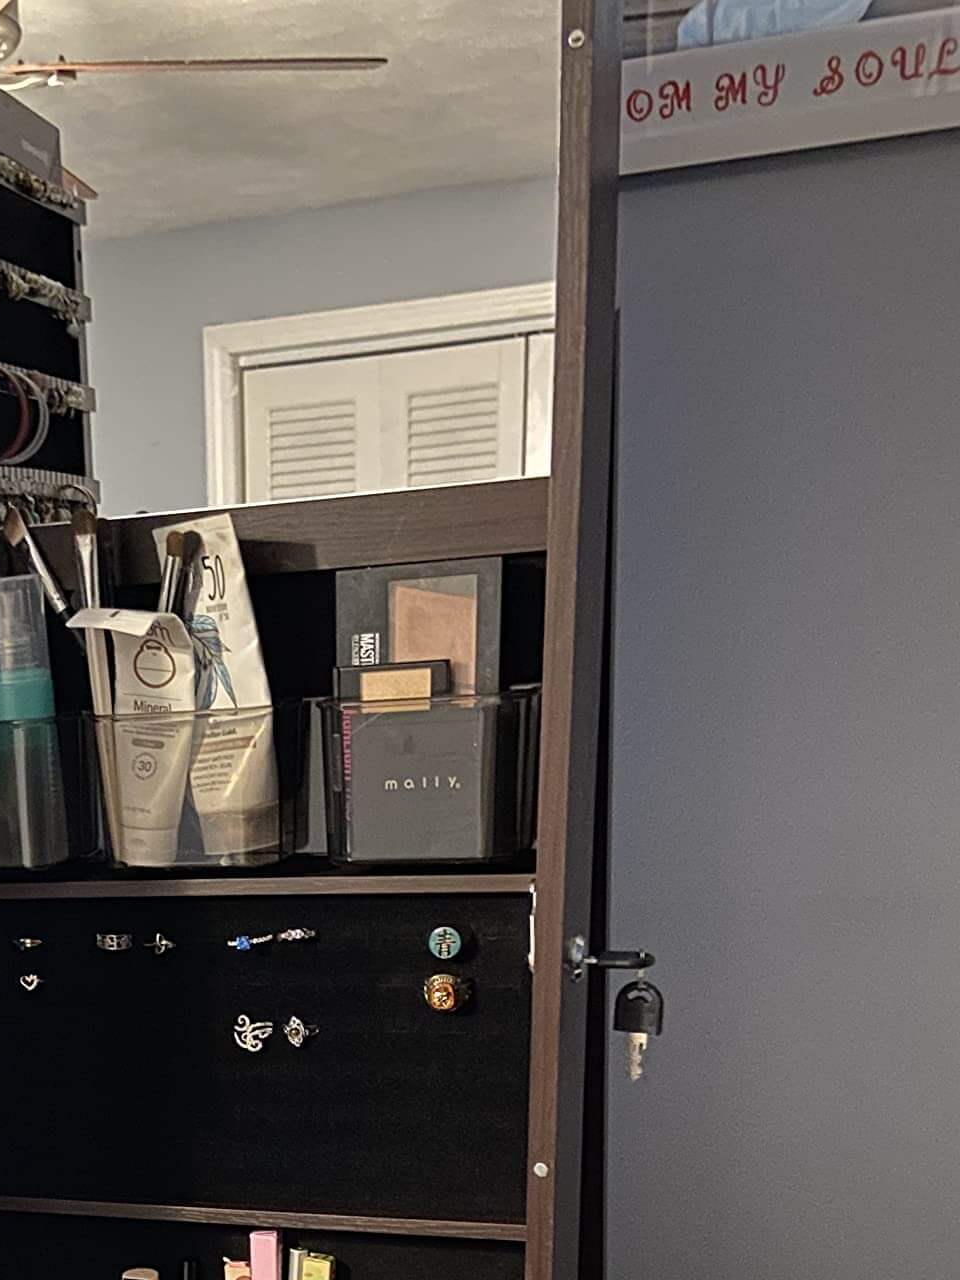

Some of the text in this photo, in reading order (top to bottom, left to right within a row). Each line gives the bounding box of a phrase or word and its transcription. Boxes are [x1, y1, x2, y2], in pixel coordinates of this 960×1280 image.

[714, 64, 785, 111] MY
[813, 38, 960, 97] SOUL
[201, 554, 226, 601] 50
[136, 759, 152, 773] 30
